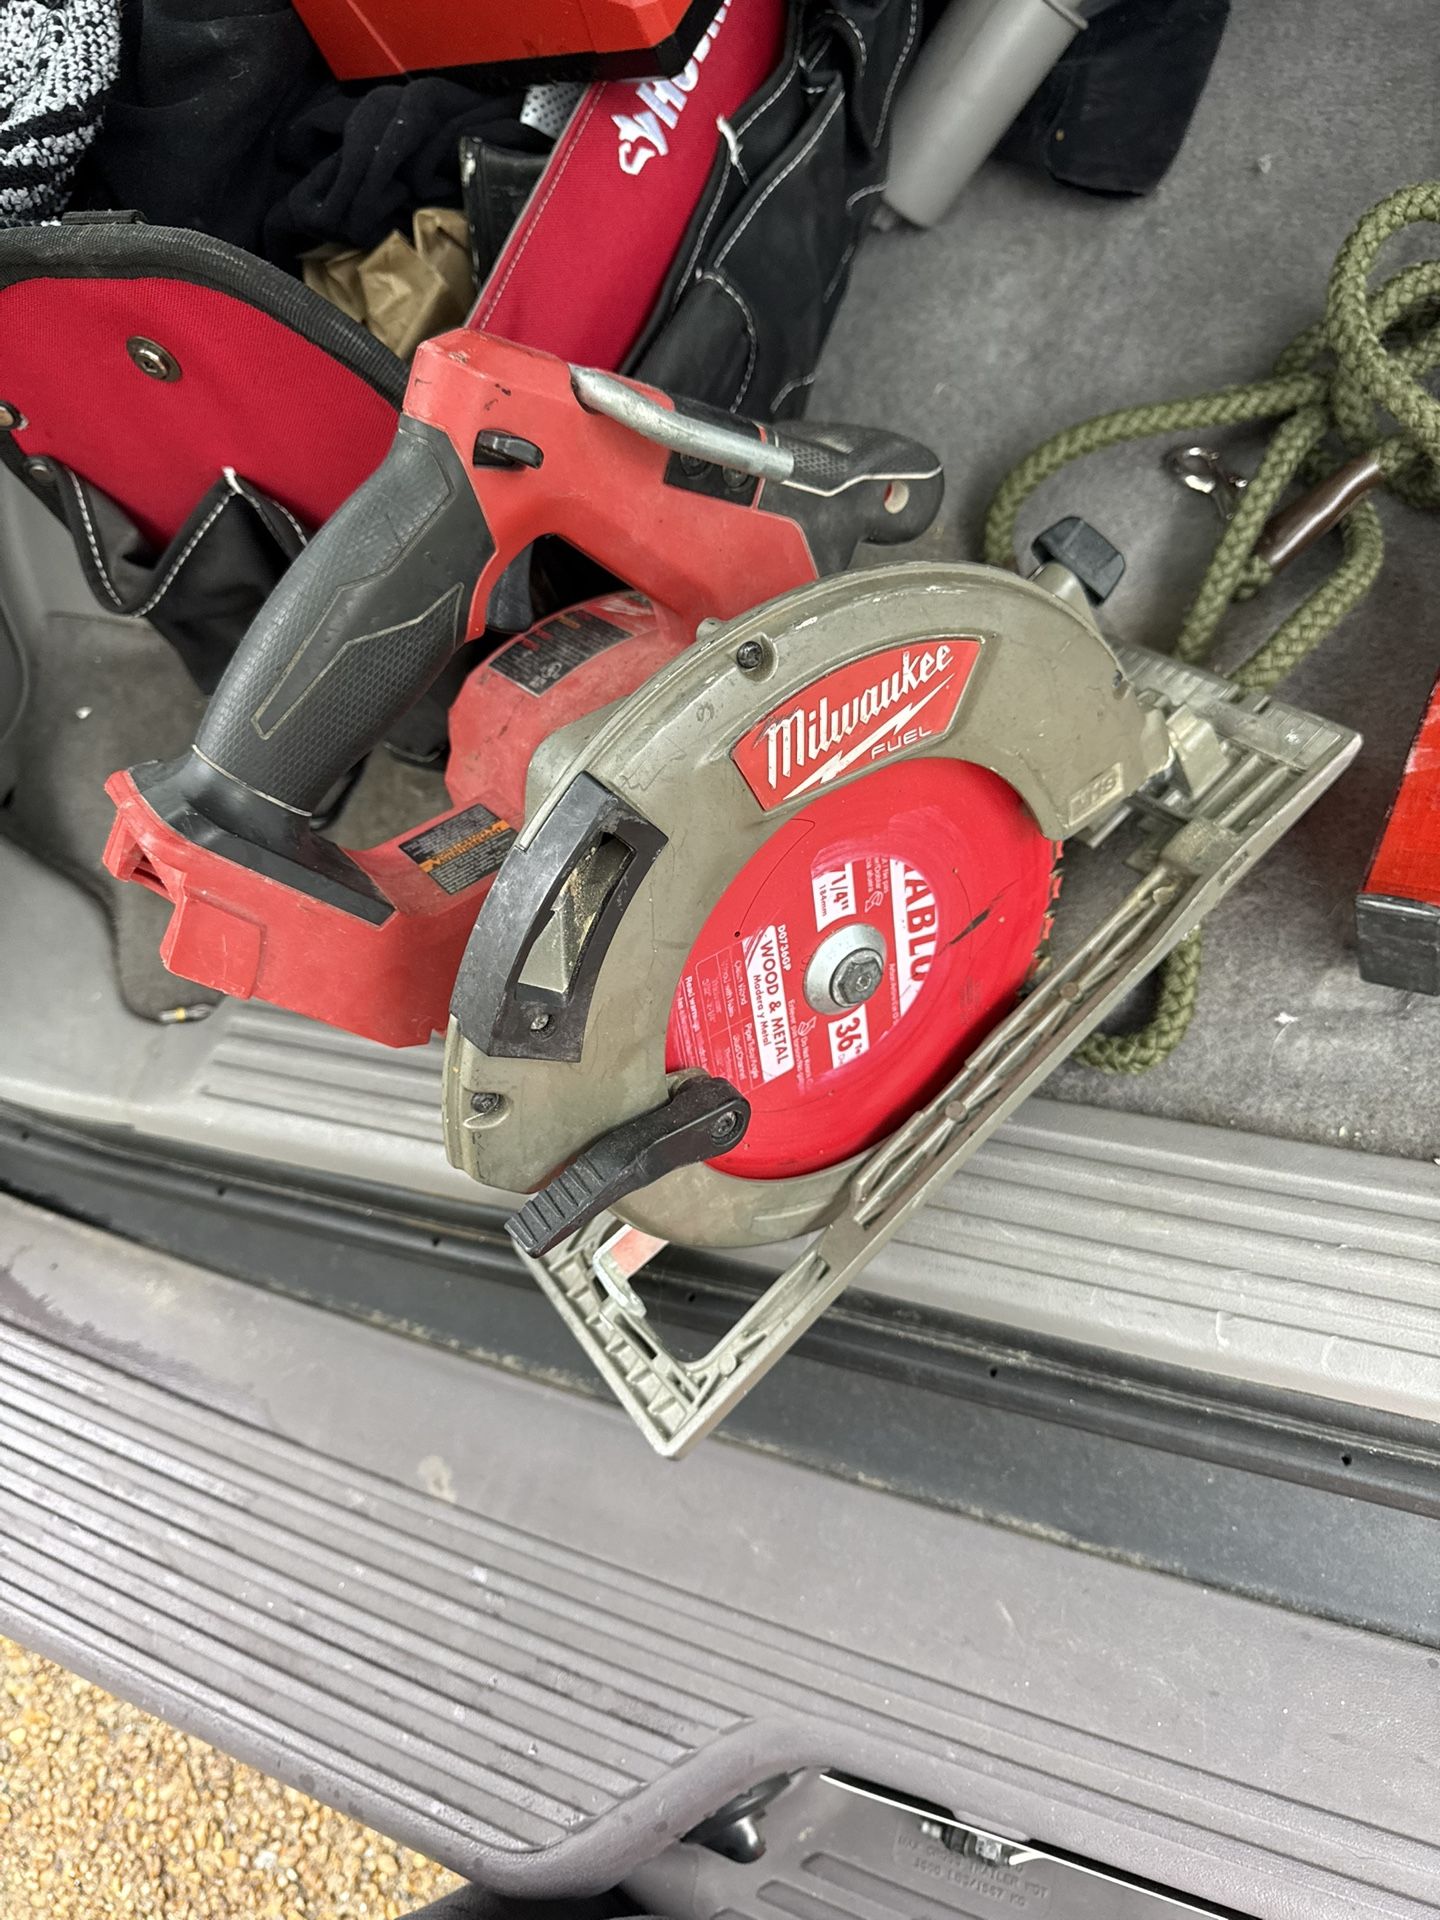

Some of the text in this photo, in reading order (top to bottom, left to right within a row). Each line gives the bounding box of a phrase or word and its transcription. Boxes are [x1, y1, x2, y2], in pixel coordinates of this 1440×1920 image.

[760, 645, 954, 789] Milwaukee
[871, 725, 933, 759] FUEL
[818, 884, 827, 916] 184mm
[685, 976, 694, 997] Read
[759, 940, 789, 1064] WOOD & METAL
[752, 974, 764, 1010] Madera
[760, 1019, 771, 1046] Metal
[835, 1016, 862, 1052] 36
